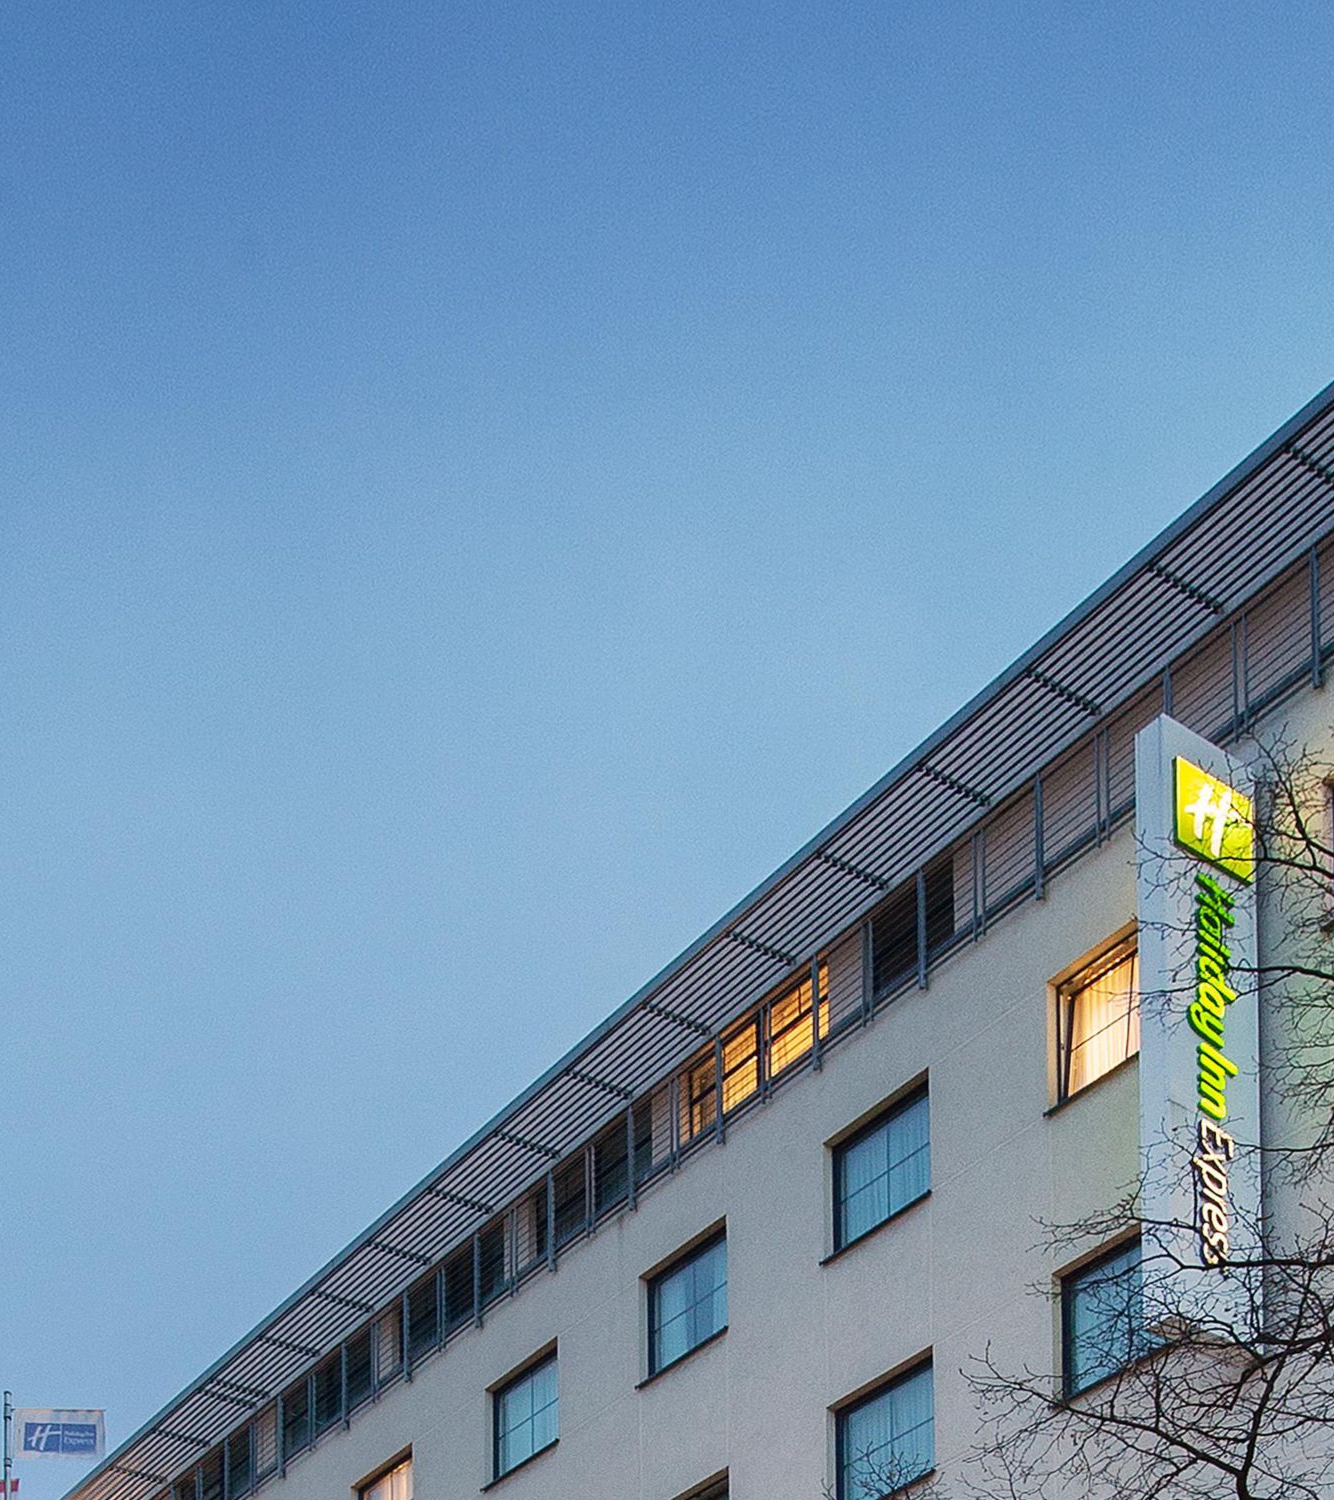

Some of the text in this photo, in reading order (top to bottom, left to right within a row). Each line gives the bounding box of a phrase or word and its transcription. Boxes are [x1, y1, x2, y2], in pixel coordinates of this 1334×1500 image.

[1189, 872, 1239, 1272] Holiday Inn Express
